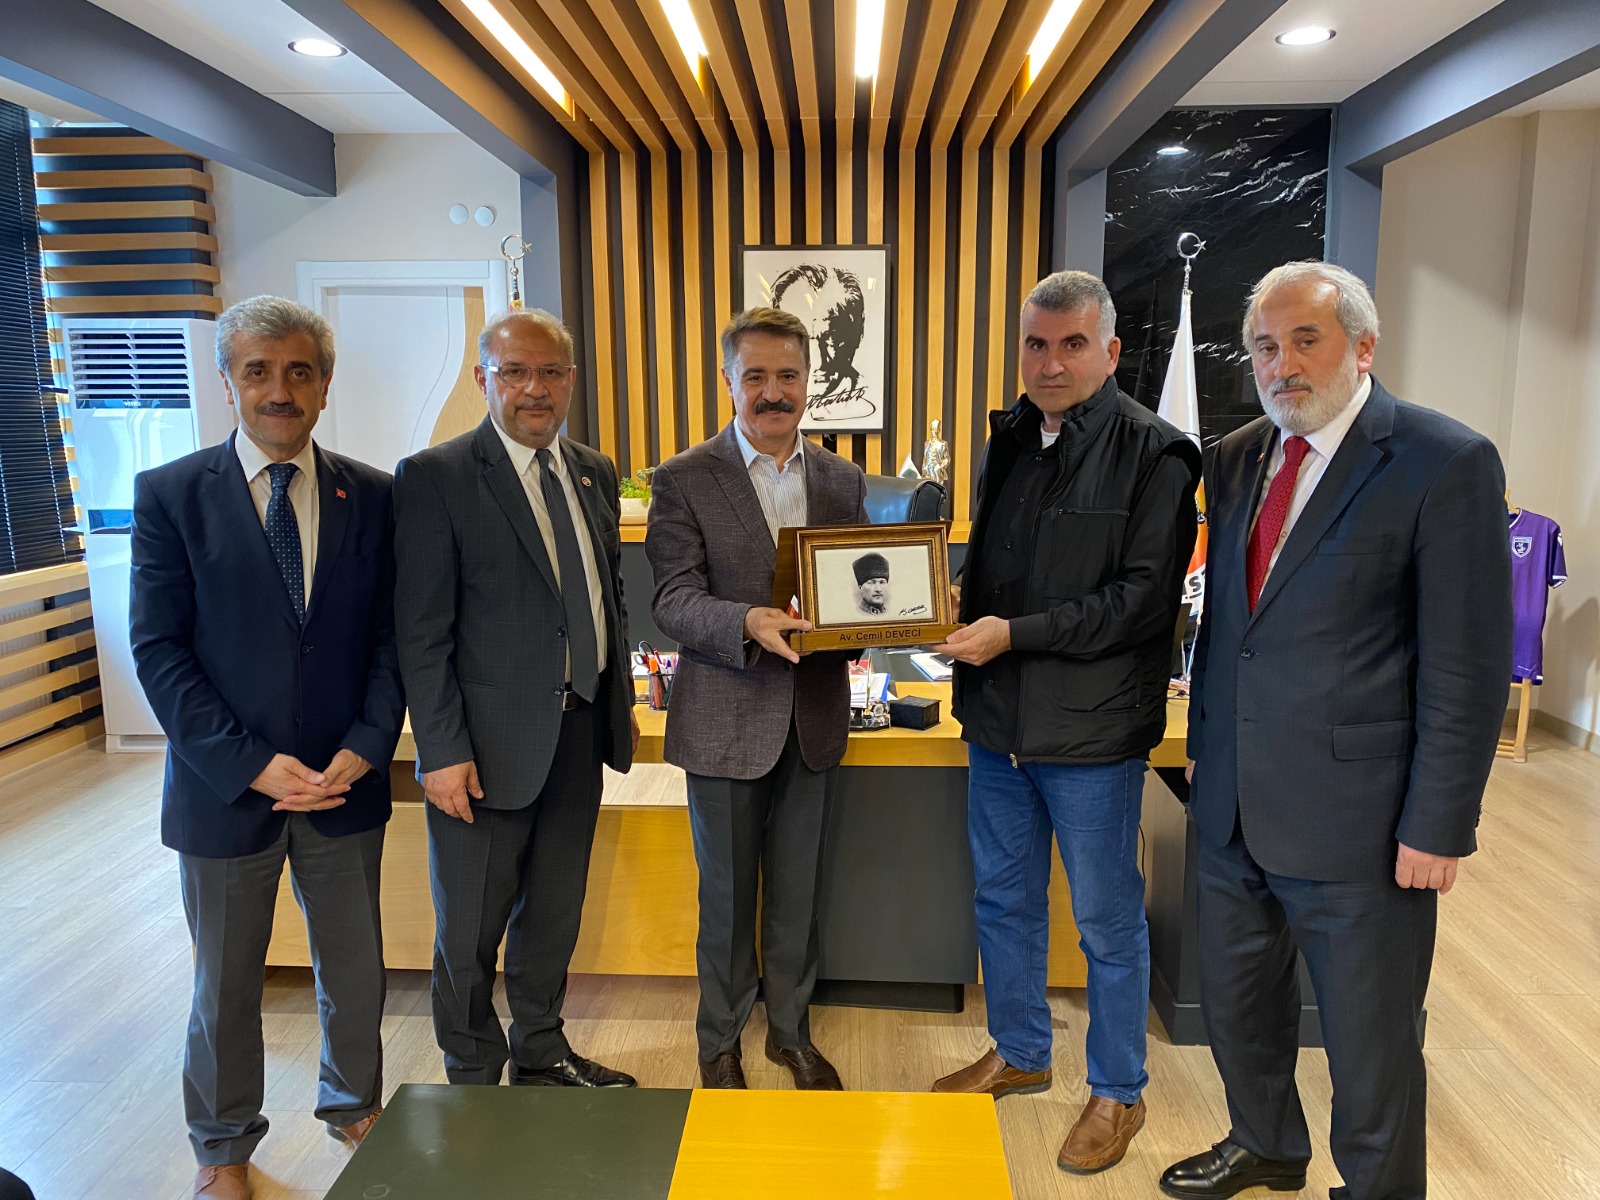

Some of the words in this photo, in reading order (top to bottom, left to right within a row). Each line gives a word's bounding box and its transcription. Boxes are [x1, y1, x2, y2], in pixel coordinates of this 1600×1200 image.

[840, 633, 853, 641] Av.
[856, 631, 882, 641] Cemil
[885, 628, 921, 639] DEVECİ
